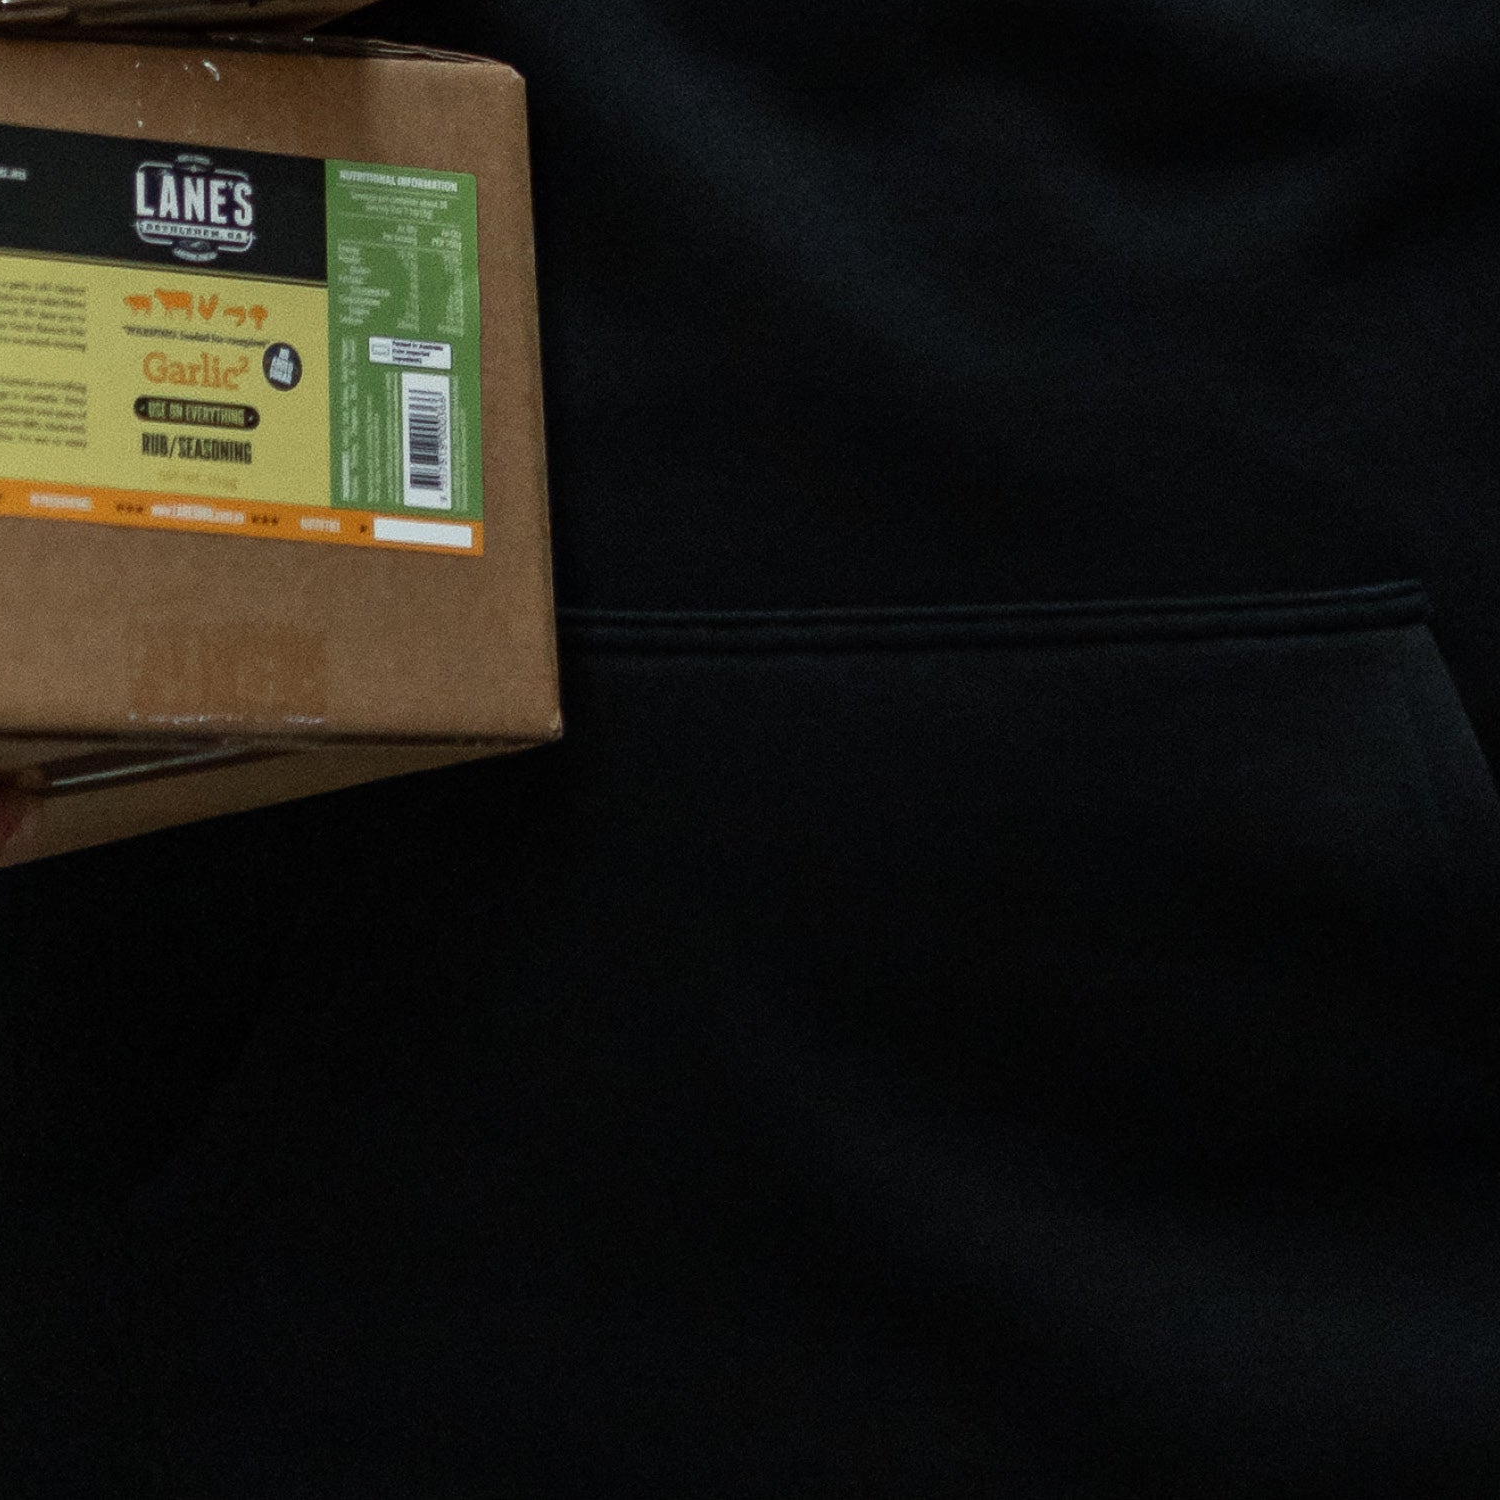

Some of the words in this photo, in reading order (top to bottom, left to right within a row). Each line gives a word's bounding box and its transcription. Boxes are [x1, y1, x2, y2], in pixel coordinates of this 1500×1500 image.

[135, 170, 254, 228] LANE'S
[147, 400, 167, 419] USE
[168, 402, 183, 420] ON
[185, 404, 245, 427] EVERYTHING
